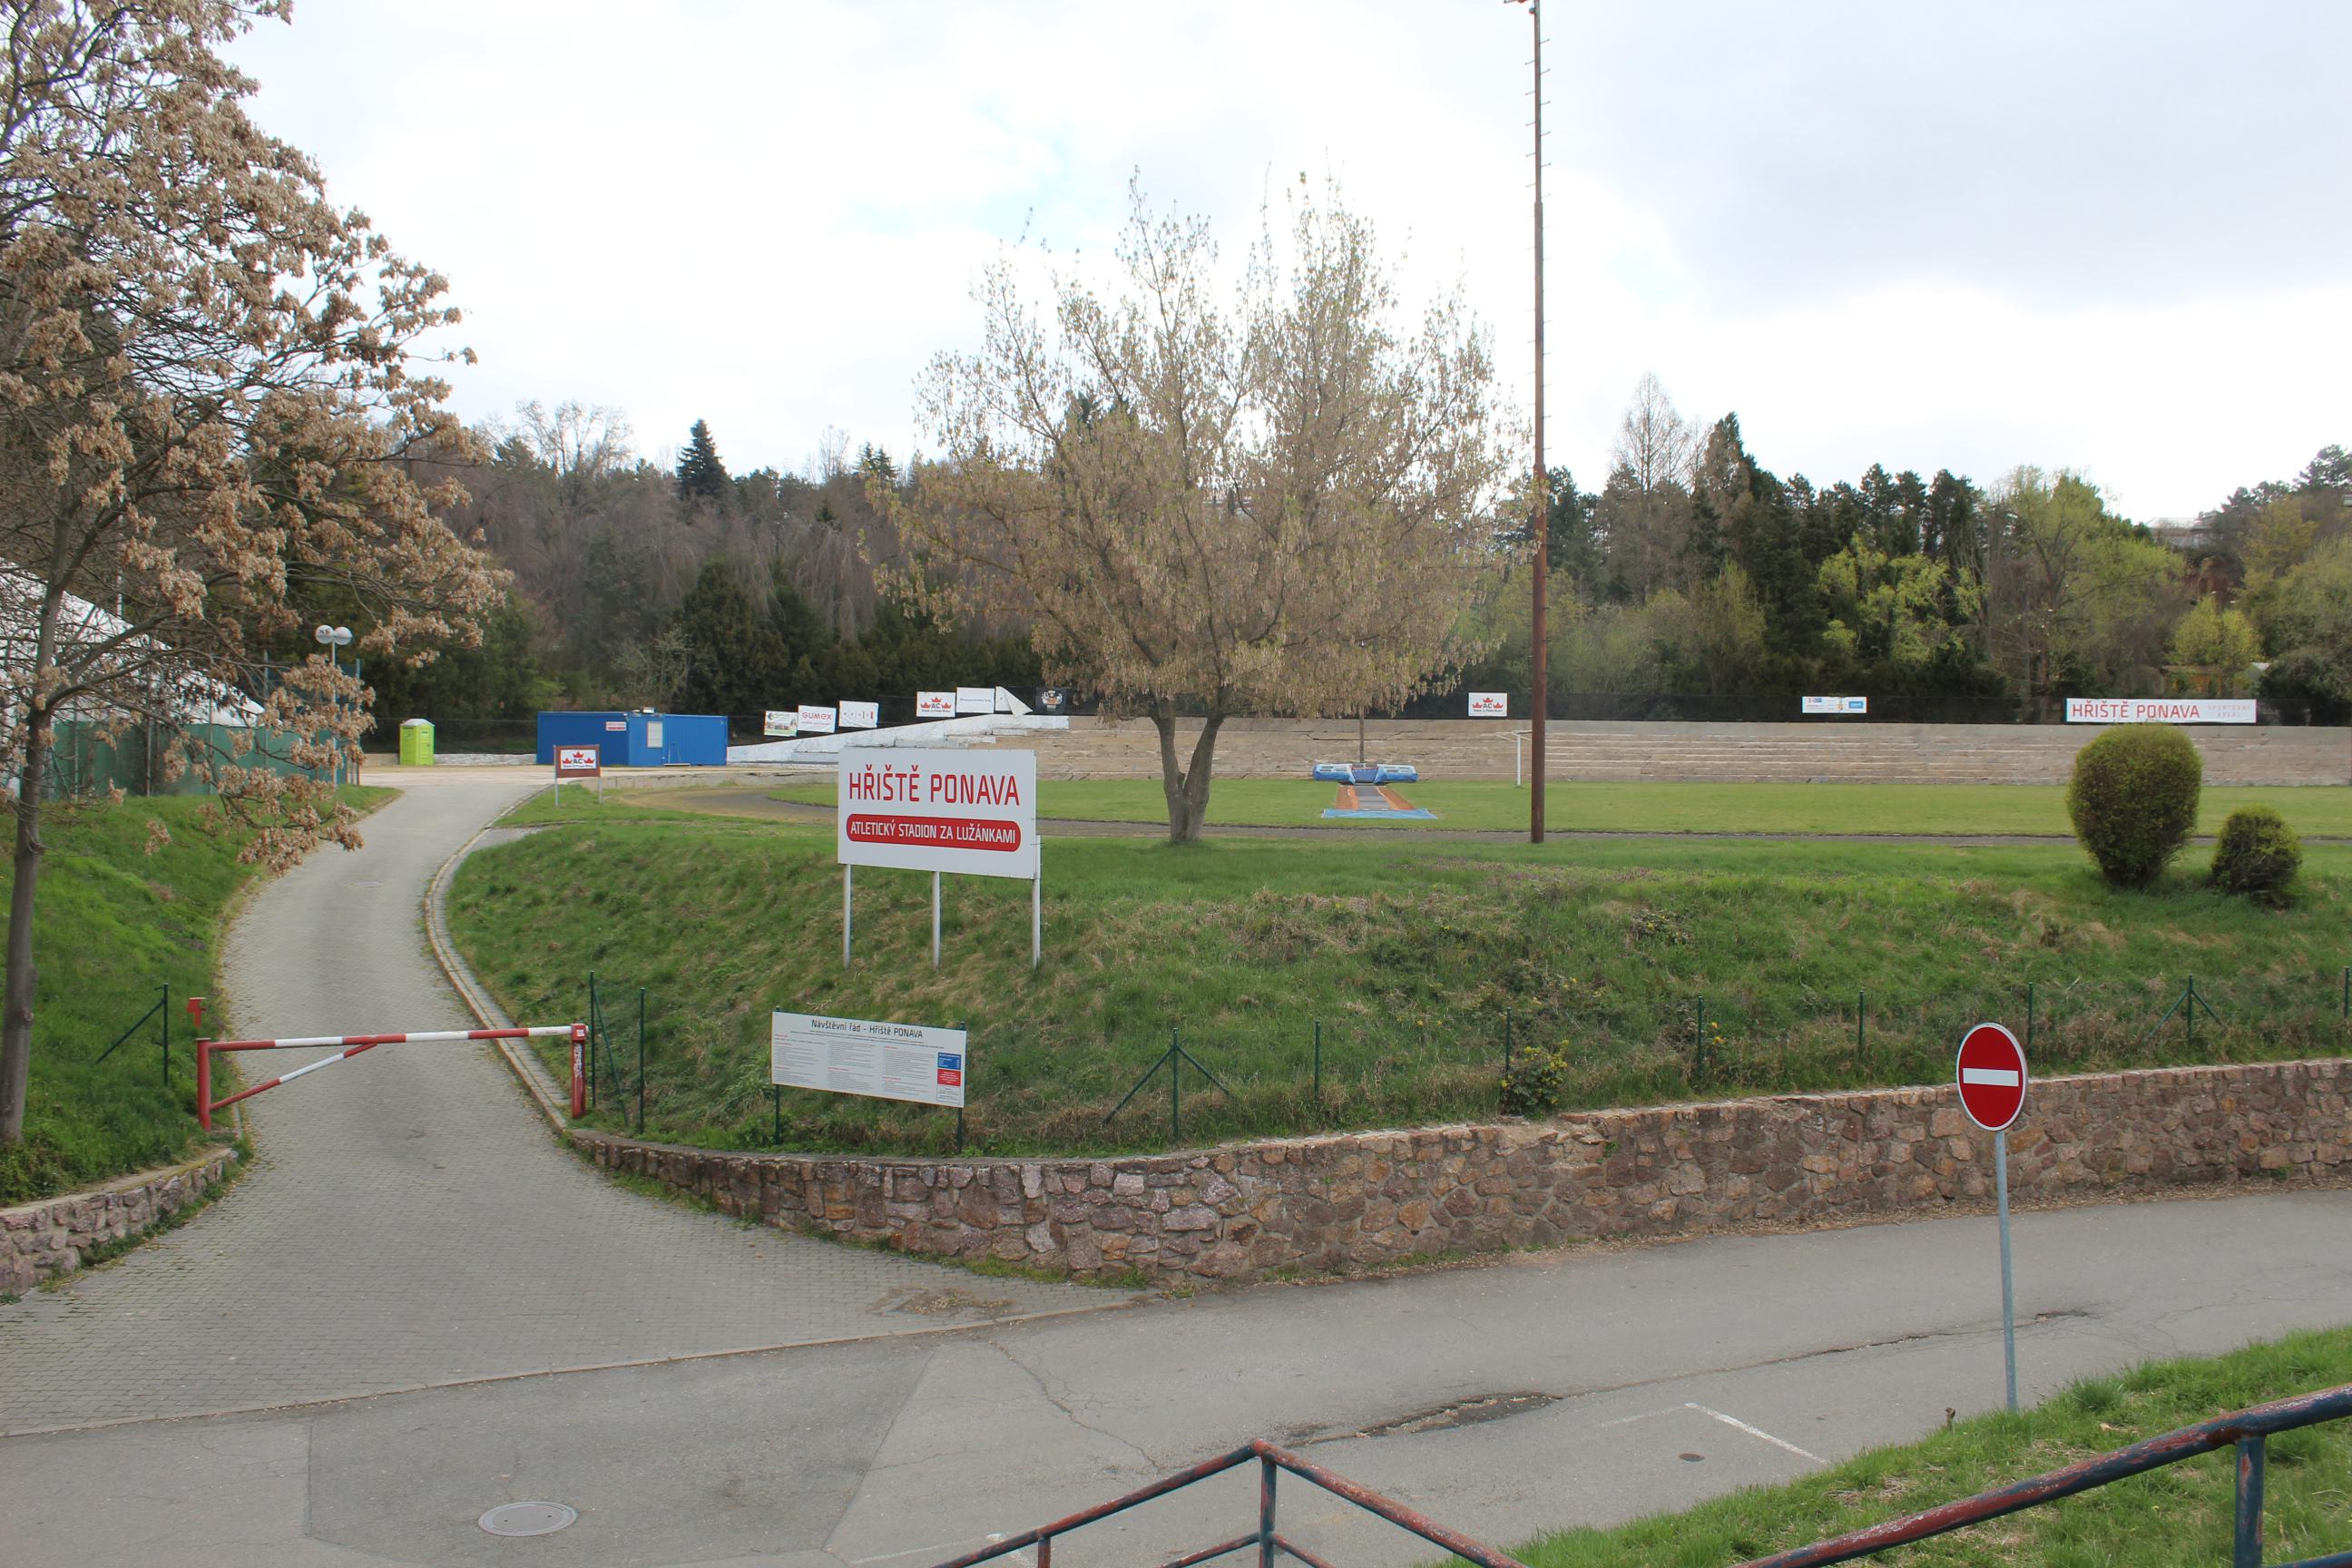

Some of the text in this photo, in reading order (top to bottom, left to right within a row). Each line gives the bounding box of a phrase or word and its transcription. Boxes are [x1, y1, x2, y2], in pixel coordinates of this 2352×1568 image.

[2073, 700, 2200, 719] HŘIŠTĚ PONAVA
[849, 764, 1020, 806] HŘIŠTĚ PONAVA
[850, 819, 1015, 844] ATLETICKÝ STADION ZA LUŽÁNKAMI
[869, 1025, 891, 1035] Hřiště
[894, 1027, 923, 1039] PONAVA
